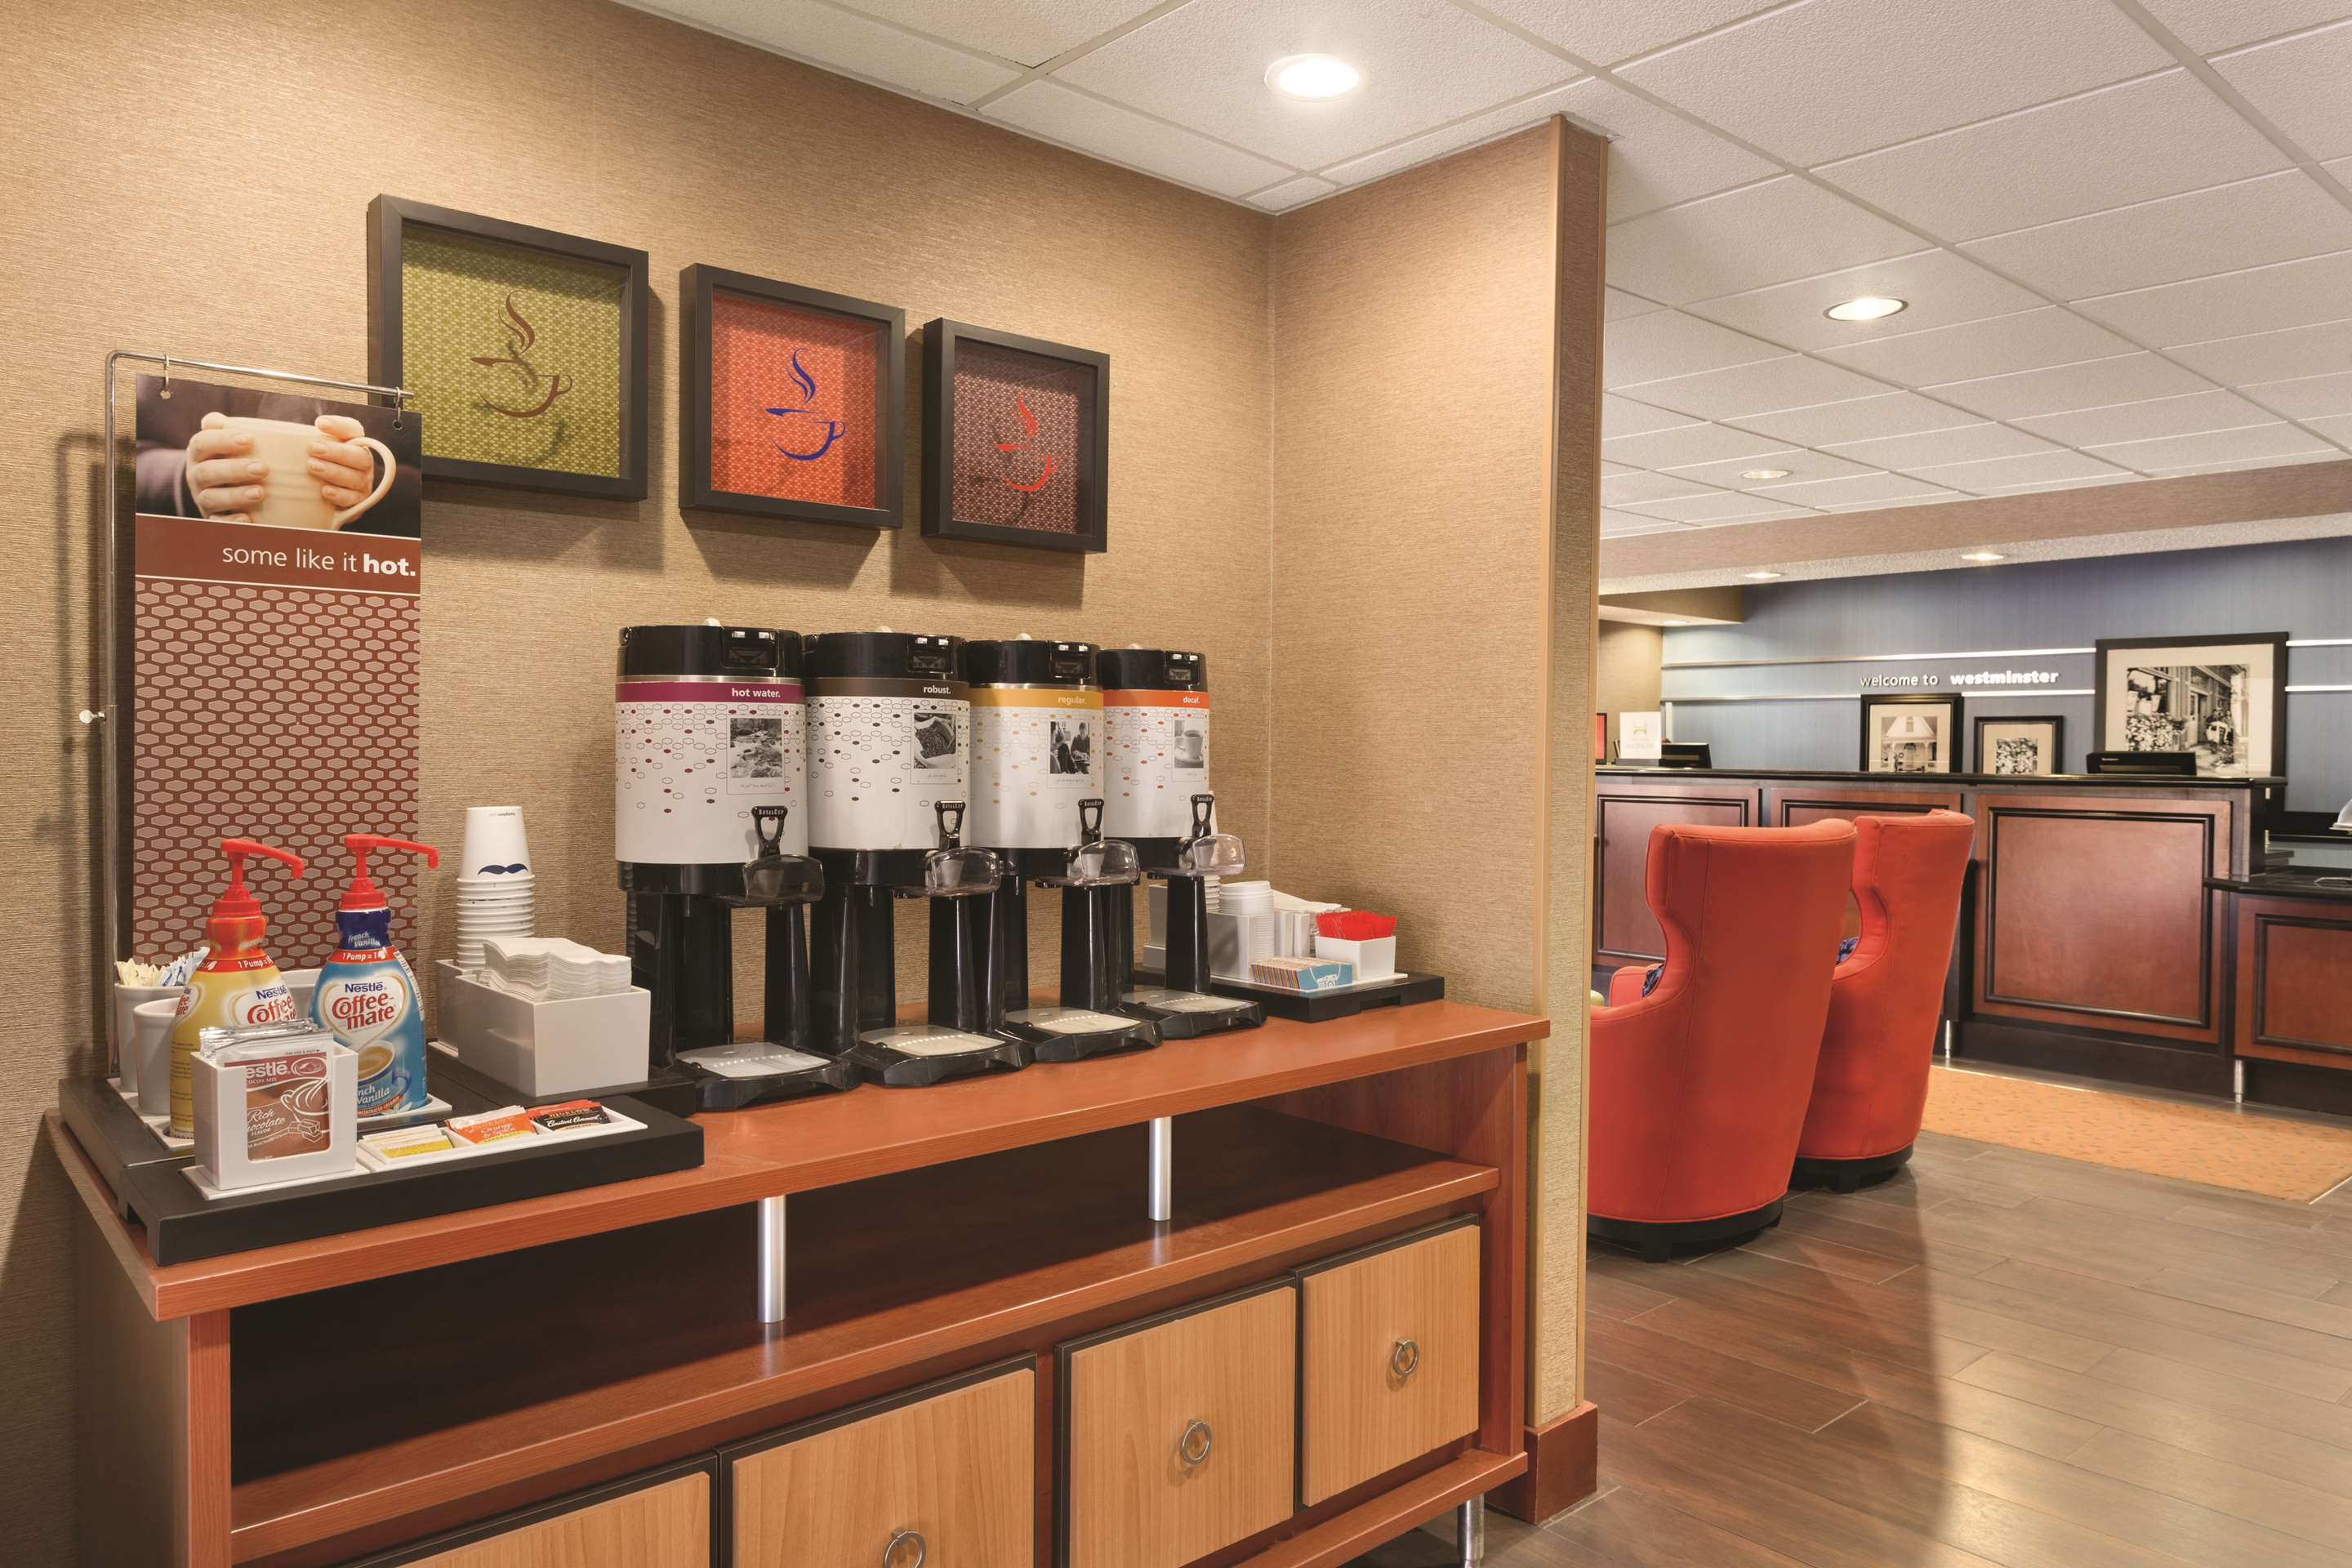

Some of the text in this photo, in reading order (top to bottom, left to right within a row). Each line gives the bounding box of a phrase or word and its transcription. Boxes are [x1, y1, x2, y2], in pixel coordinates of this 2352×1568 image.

[222, 547, 416, 577] some like it hot.
[1860, 670, 2060, 688] welcome to westminster
[731, 687, 782, 698] hot water.
[923, 684, 951, 694] robust.
[1058, 695, 1087, 706] regular.
[348, 931, 369, 944] French
[354, 938, 381, 947] Vanilla
[346, 952, 367, 962] Pump
[244, 960, 263, 969] Pump
[347, 1005, 395, 1030] mate
[246, 1060, 288, 1079] estlé
[358, 1085, 376, 1096] nch
[247, 1108, 275, 1123] Rich
